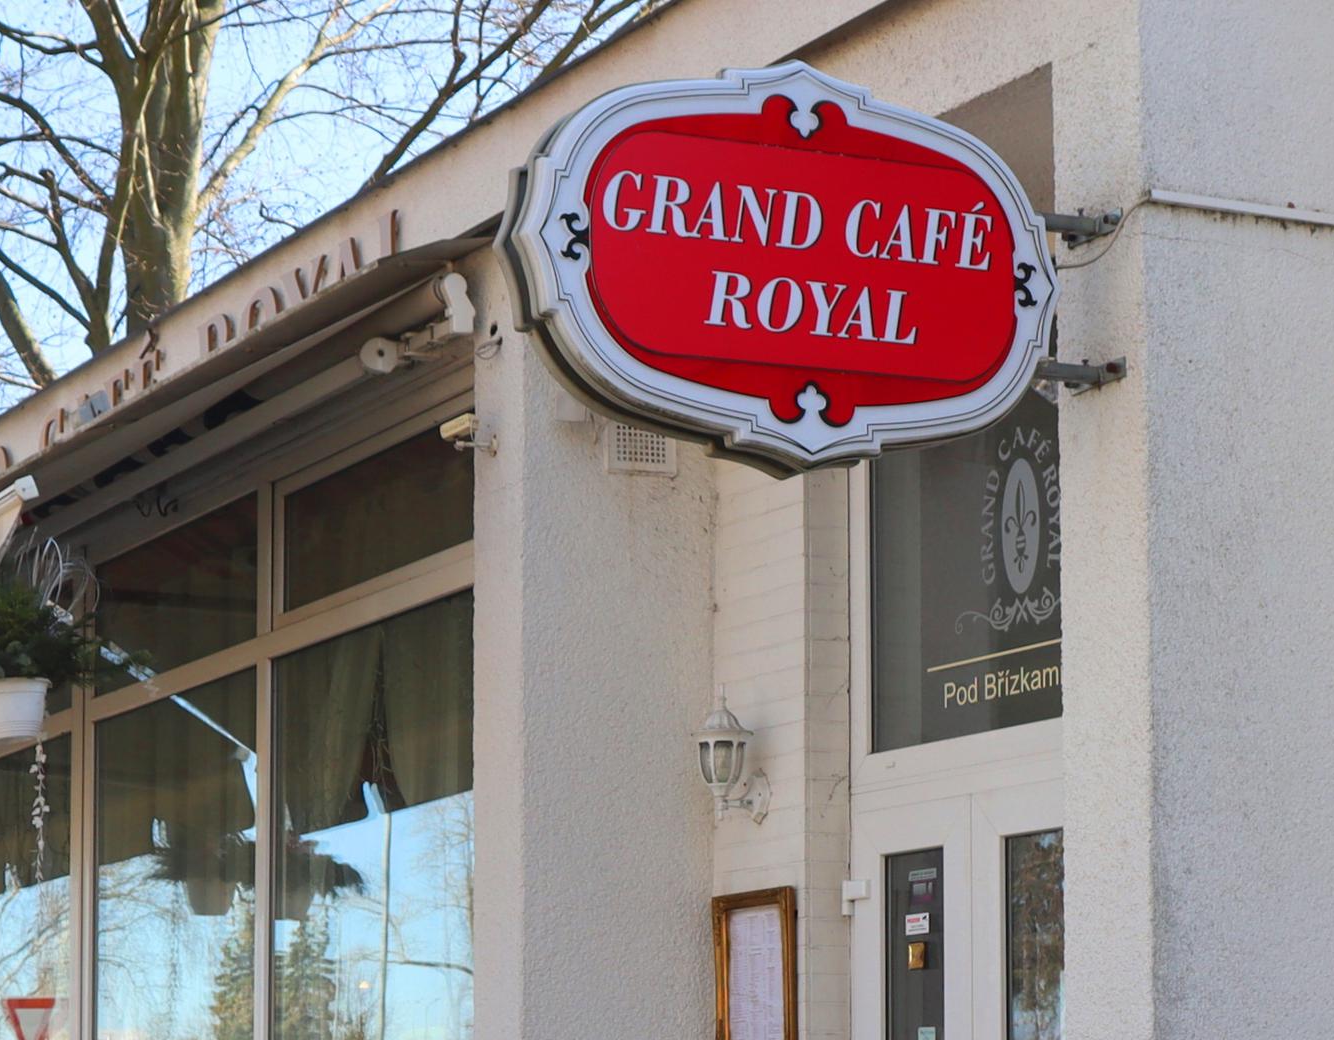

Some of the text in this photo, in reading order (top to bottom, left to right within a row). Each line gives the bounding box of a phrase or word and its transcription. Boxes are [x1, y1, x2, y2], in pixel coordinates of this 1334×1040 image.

[602, 169, 994, 272] GRAND CAFÉ
[703, 270, 919, 346] ROYAL
[981, 426, 1062, 585] GRAND CAFÉ ROYAL
[944, 676, 978, 708] Pod
